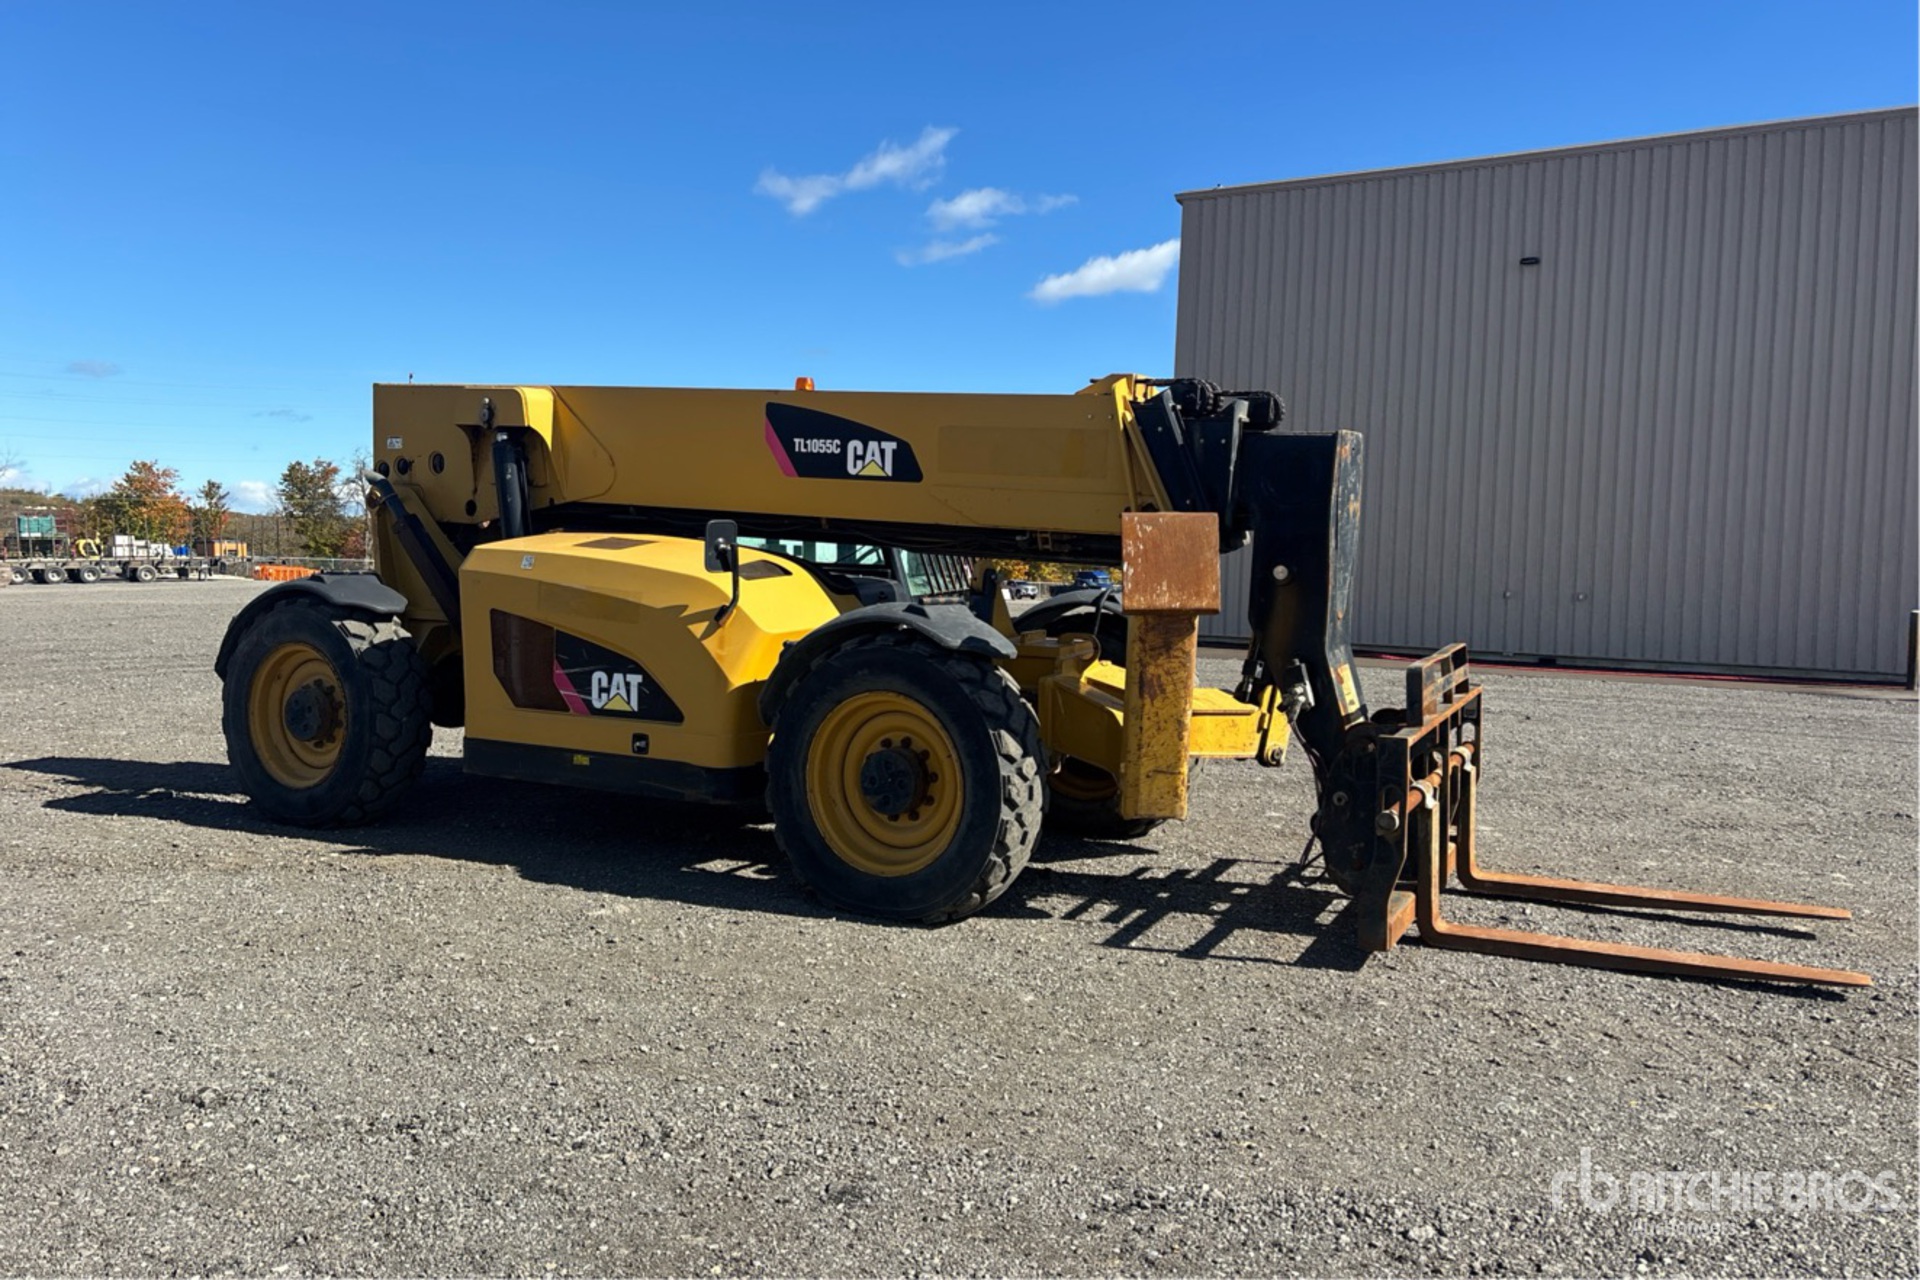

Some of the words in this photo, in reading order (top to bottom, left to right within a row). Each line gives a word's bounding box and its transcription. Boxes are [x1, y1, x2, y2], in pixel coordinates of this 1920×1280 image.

[793, 438, 841, 454] TL1055C
[846, 439, 897, 477] CAT
[591, 670, 643, 712] CAT
